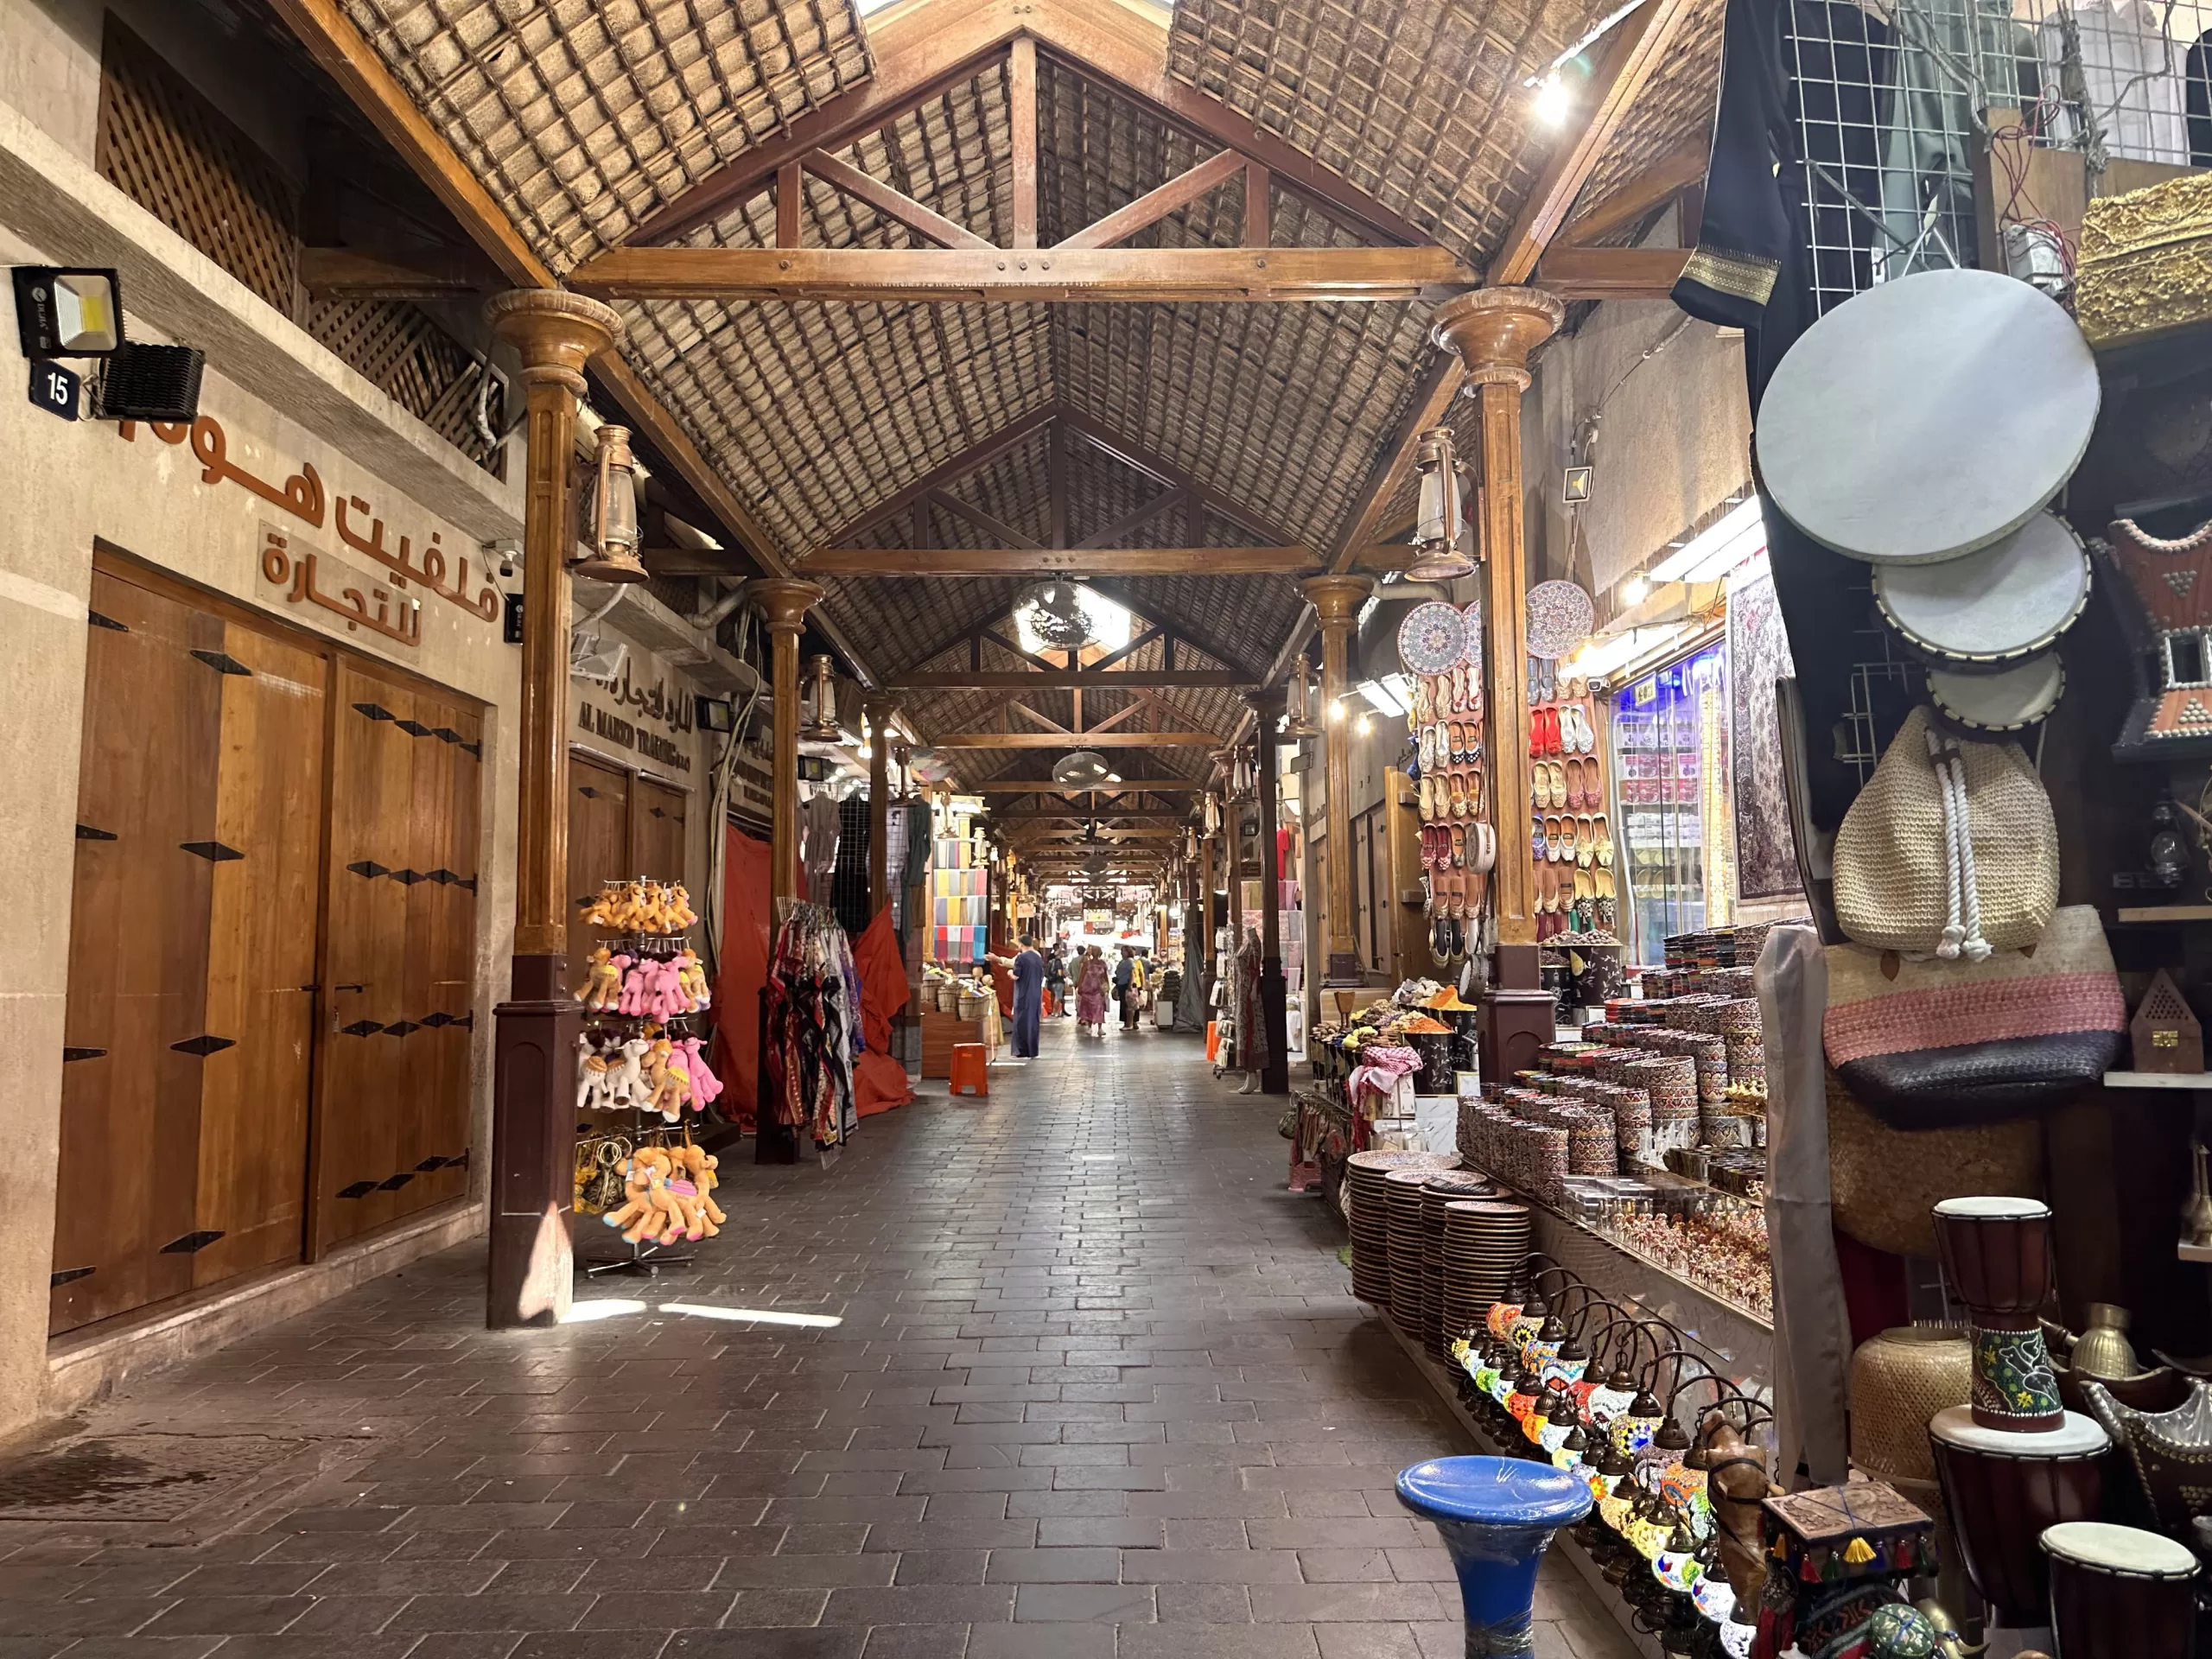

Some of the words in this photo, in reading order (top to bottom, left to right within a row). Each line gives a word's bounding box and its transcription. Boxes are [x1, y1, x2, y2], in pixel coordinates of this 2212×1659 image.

[47, 372, 68, 405] 15
[263, 532, 422, 647] للتجارة
[578, 701, 594, 733] AL
